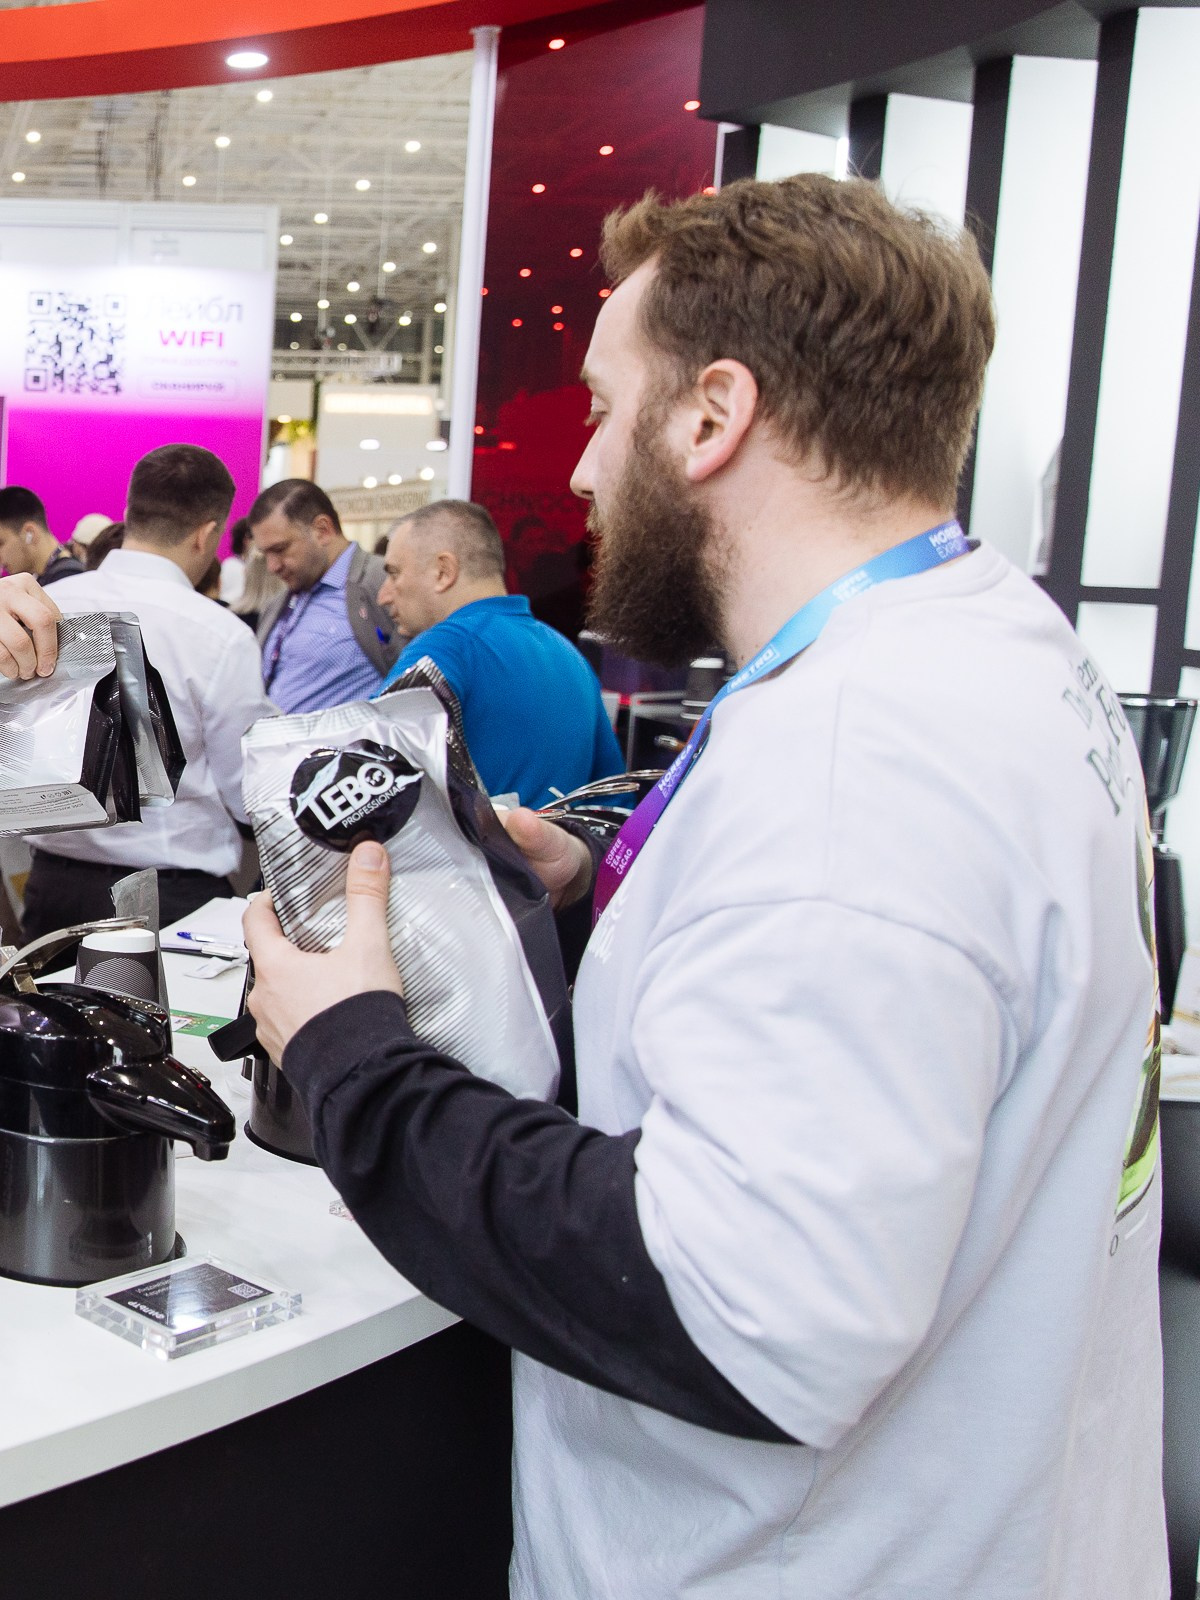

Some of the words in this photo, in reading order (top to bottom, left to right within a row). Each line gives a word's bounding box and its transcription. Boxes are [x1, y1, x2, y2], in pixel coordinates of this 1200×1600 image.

[159, 330, 225, 348] WIFI
[730, 648, 775, 690] METRO
[658, 744, 693, 792] HORECA
[306, 762, 395, 831] LEBO
[341, 784, 406, 829] PROFESSIONAL
[605, 838, 623, 865] COFFEE
[610, 853, 622, 870] TEA
[616, 849, 633, 875] CACAO
